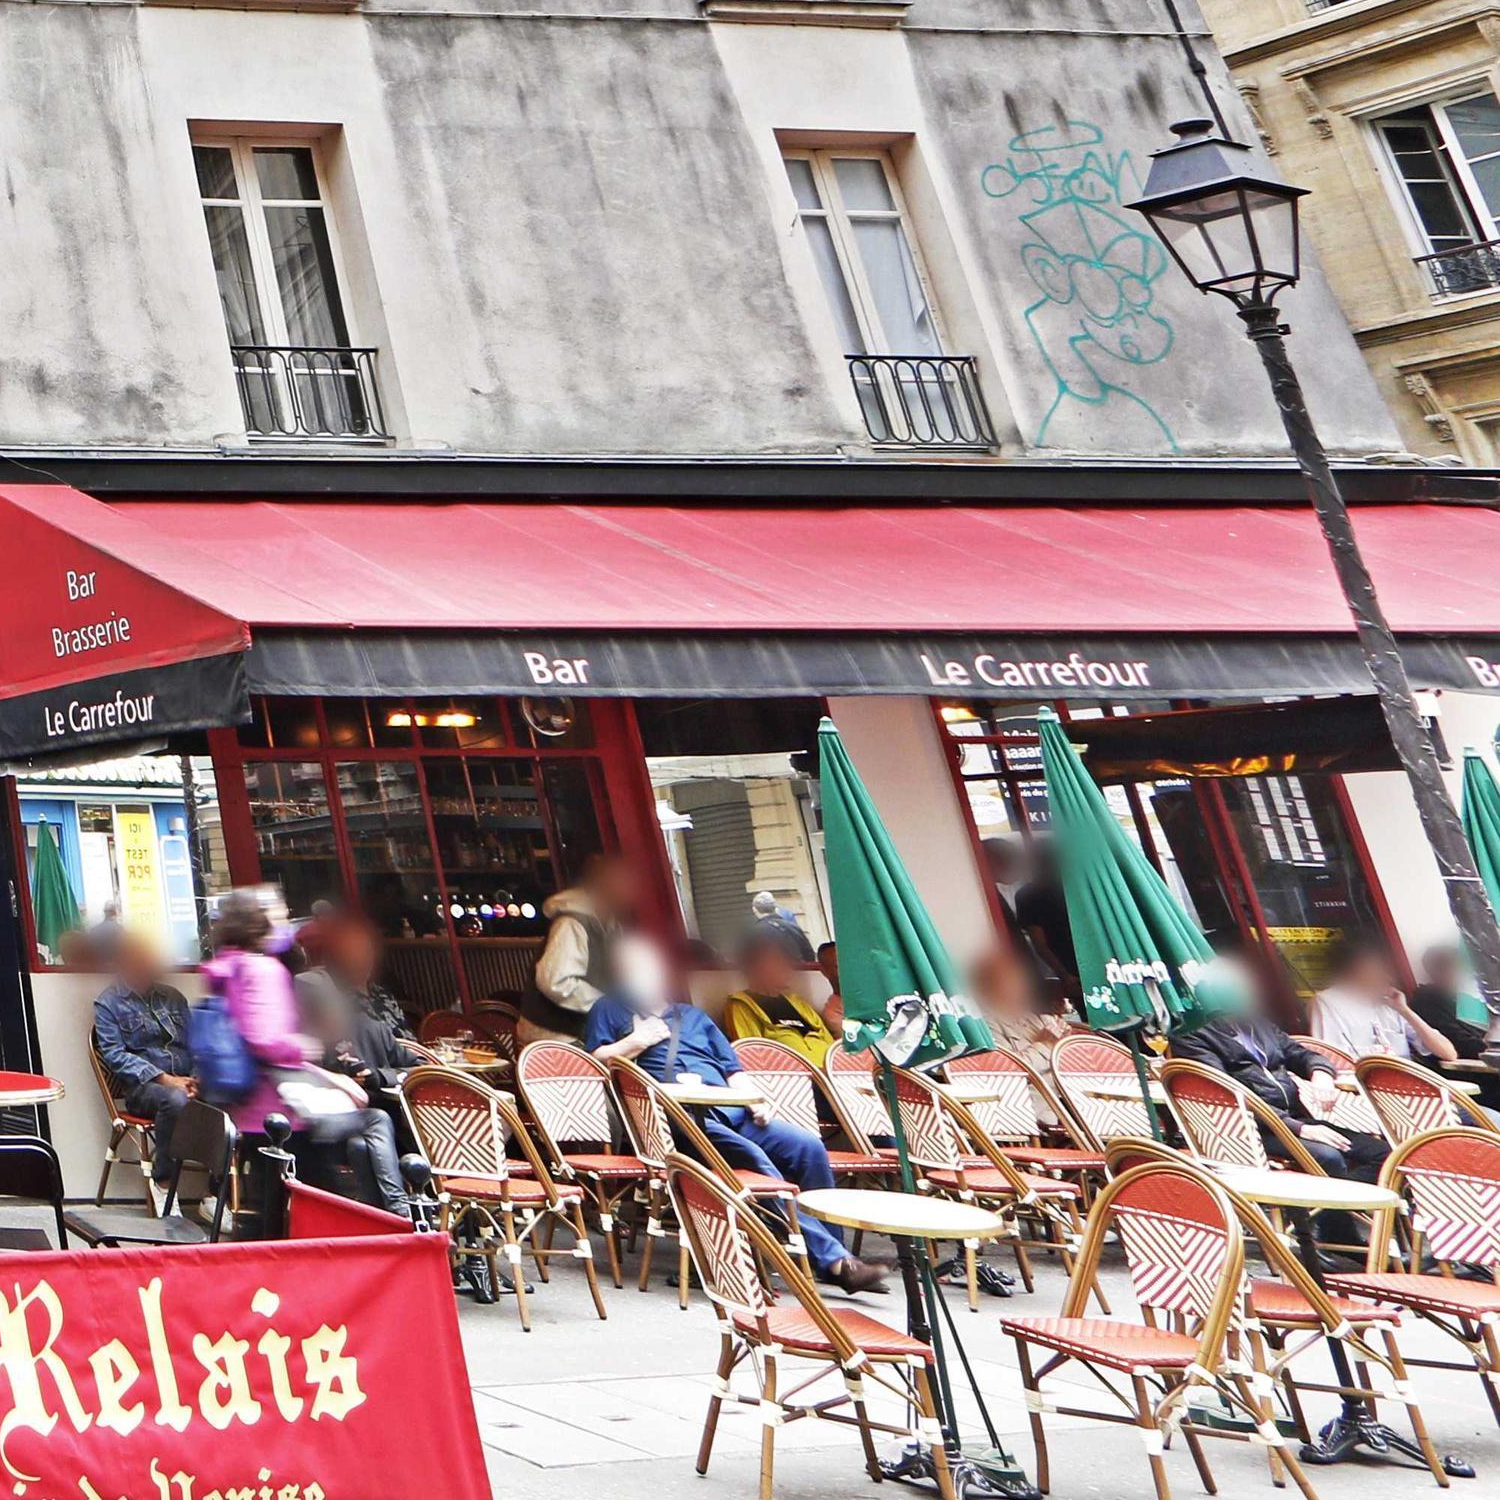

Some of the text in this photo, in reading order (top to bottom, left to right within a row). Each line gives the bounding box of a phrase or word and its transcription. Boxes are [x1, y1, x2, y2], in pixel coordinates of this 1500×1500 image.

[66, 569, 96, 601] Bar
[51, 610, 131, 658] Brasserie
[523, 652, 589, 684] Bar
[920, 652, 1151, 687] Le Carrefour
[44, 689, 154, 737] Le Carrefour
